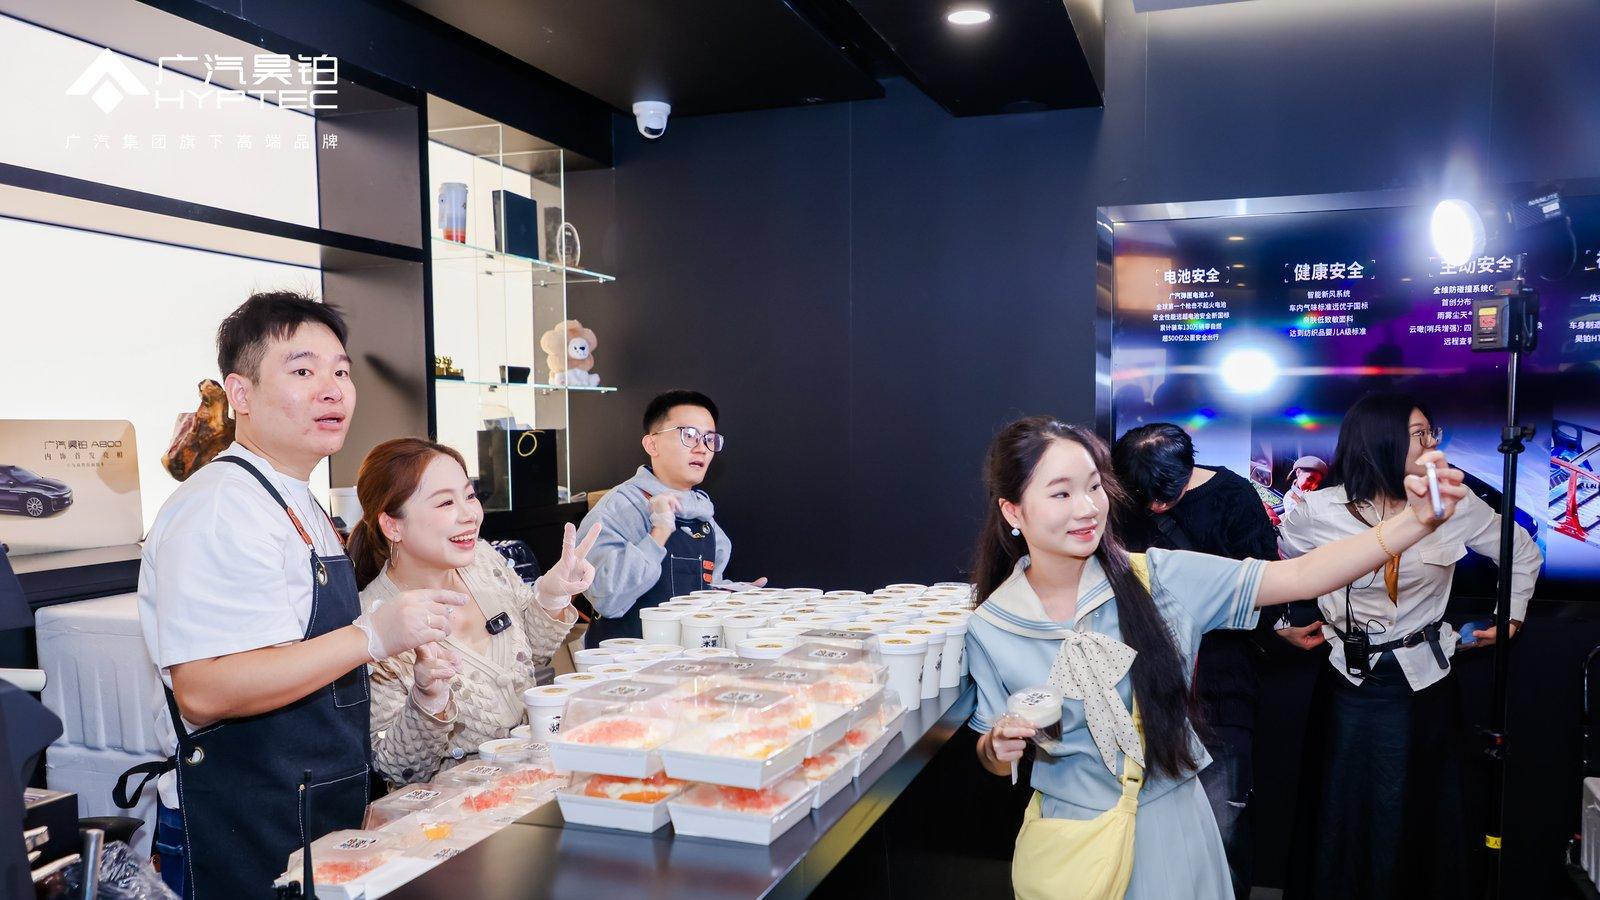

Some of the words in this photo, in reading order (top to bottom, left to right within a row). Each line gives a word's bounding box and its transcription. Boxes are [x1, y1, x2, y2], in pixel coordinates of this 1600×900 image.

[1164, 267, 1220, 284] 电池安全
[1294, 261, 1364, 281] 健康安全
[1307, 290, 1351, 299] 智能新风系统
[1433, 285, 1497, 295] 全维防碰撞系统C
[1289, 302, 1369, 312] 车内气味标准远优于国标
[1441, 298, 1473, 307] 首创分布
[1289, 328, 1367, 337] 达到纺织品婴儿A级标准
[44, 440, 87, 449] 广汽昊铂
[91, 440, 122, 448] A800
[44, 451, 123, 460] 内饰首发亮相
